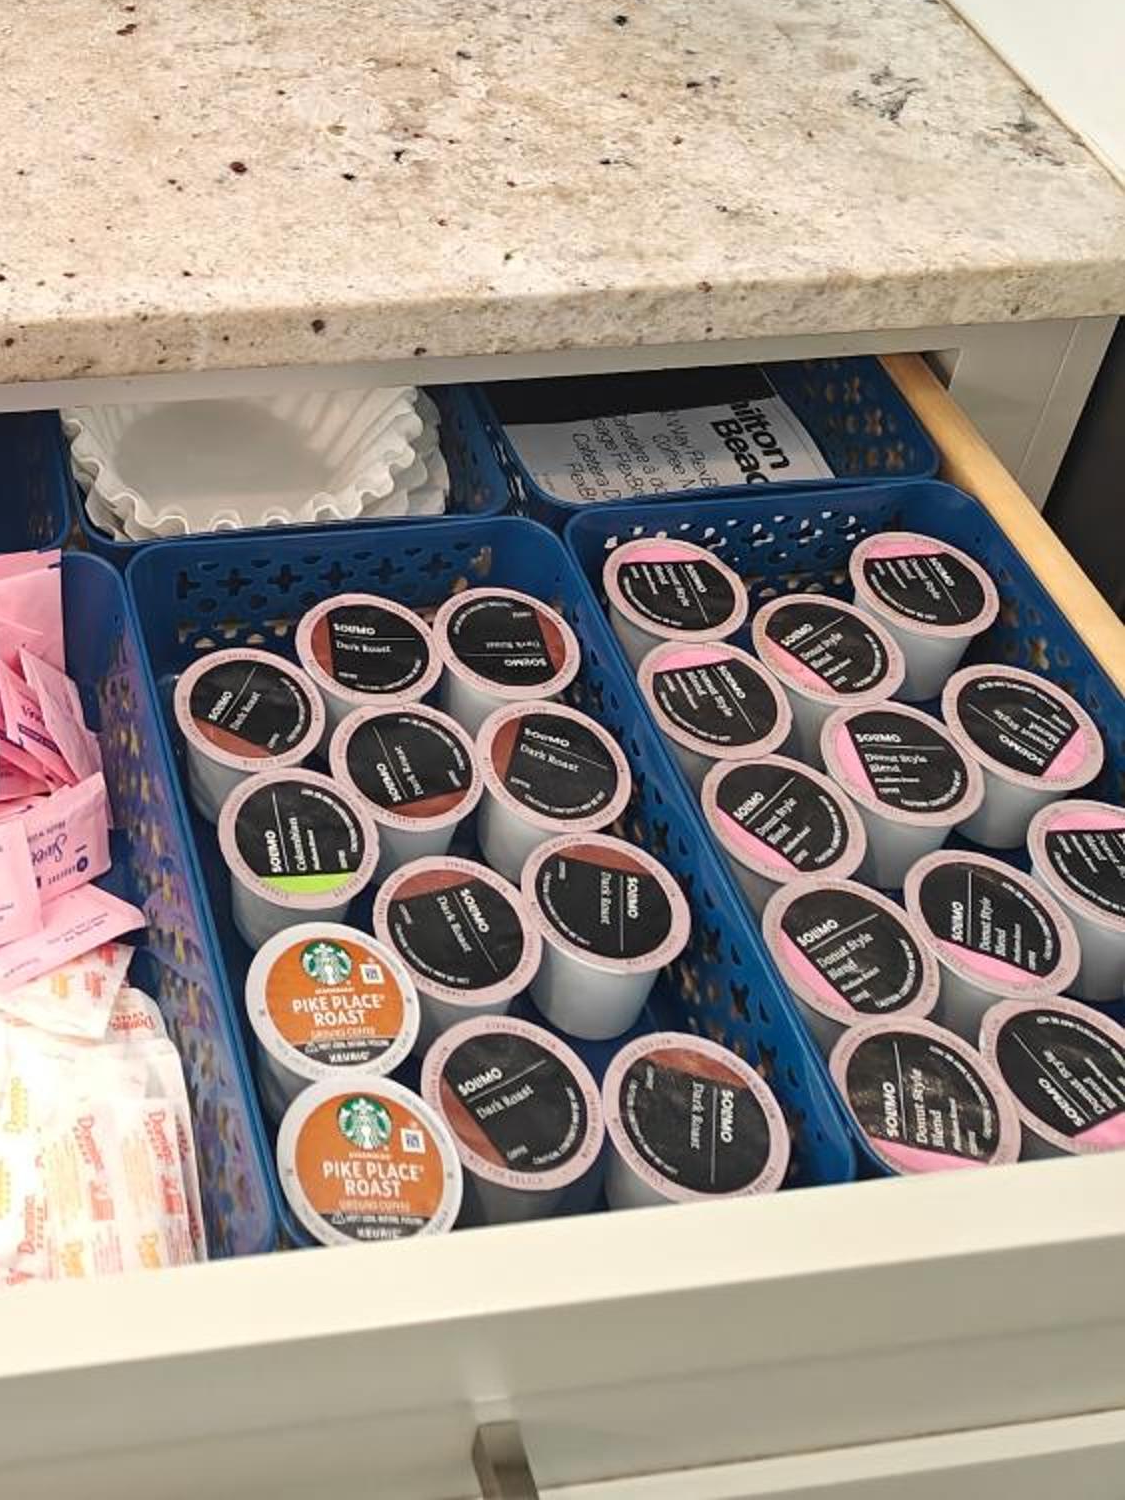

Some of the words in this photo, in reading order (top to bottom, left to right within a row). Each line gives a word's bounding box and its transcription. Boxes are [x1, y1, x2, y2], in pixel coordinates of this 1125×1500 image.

[710, 418, 770, 485] Beac
[292, 996, 331, 1013] PIKE
[314, 1010, 365, 1028] ROAST
[322, 1161, 364, 1178] PIKE
[344, 1179, 402, 1199] ROAST
